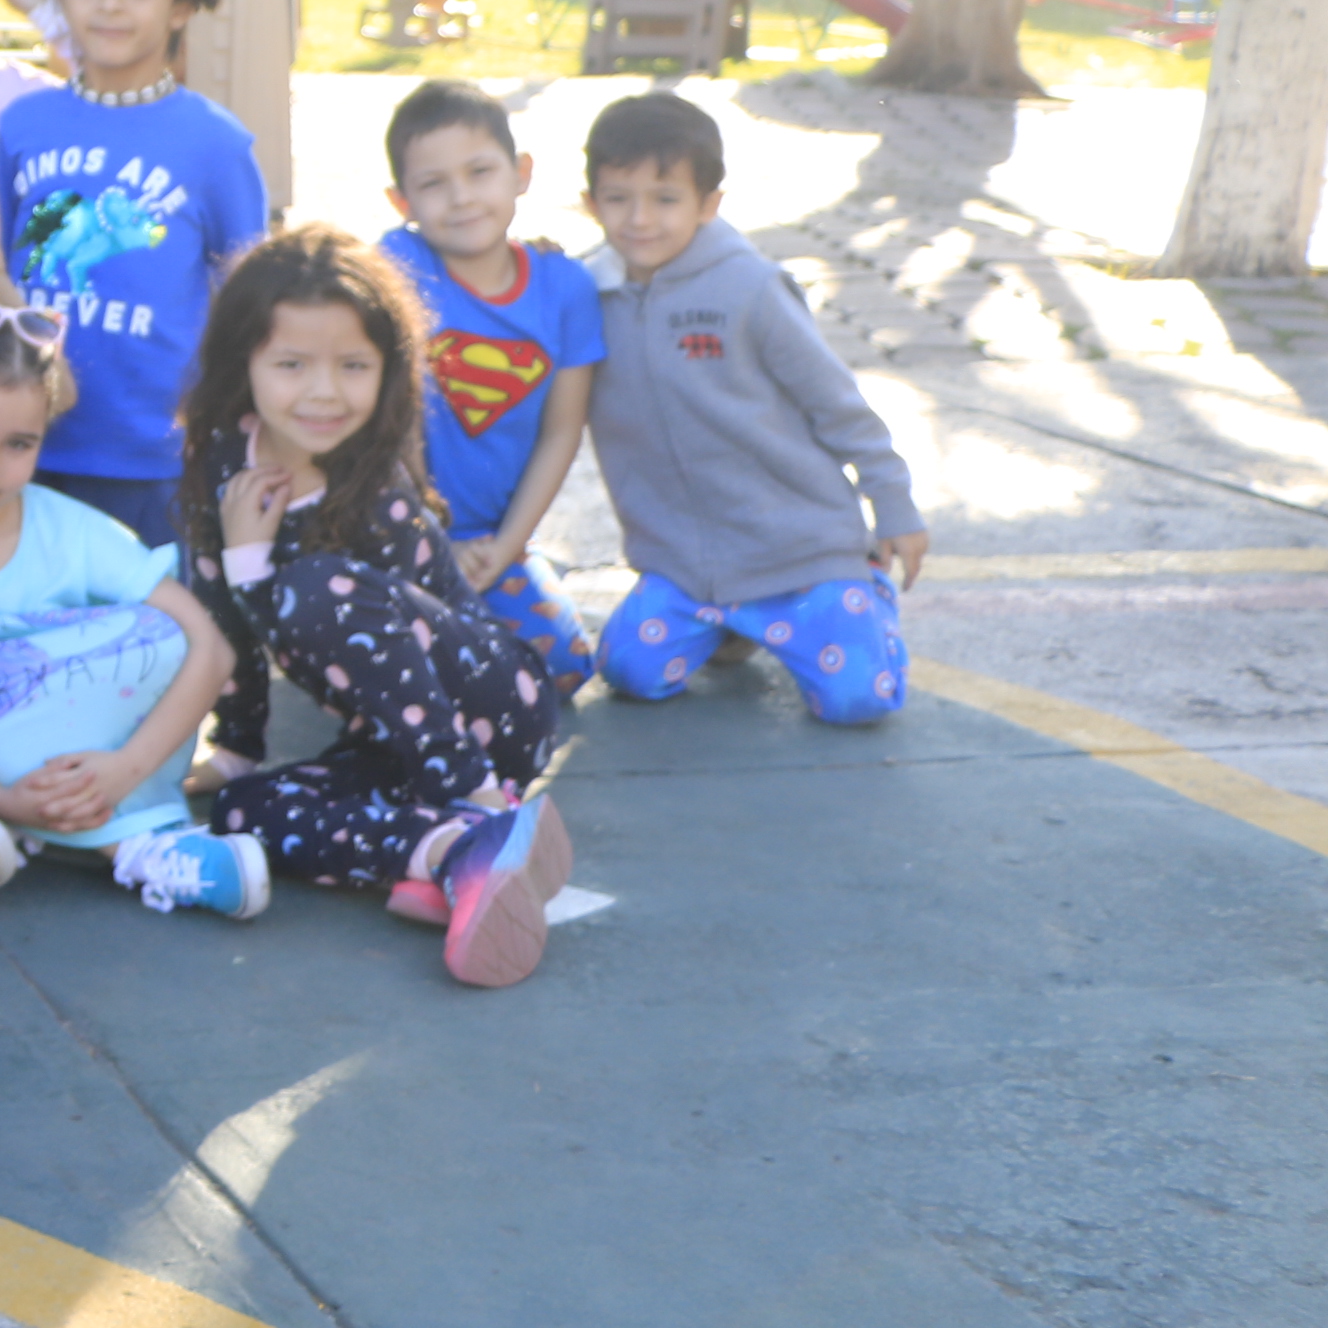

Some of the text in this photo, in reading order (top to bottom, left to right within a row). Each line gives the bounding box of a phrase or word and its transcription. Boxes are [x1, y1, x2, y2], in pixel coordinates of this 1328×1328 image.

[13, 145, 189, 218] DINOS ARE
[16, 281, 154, 338] REVER
